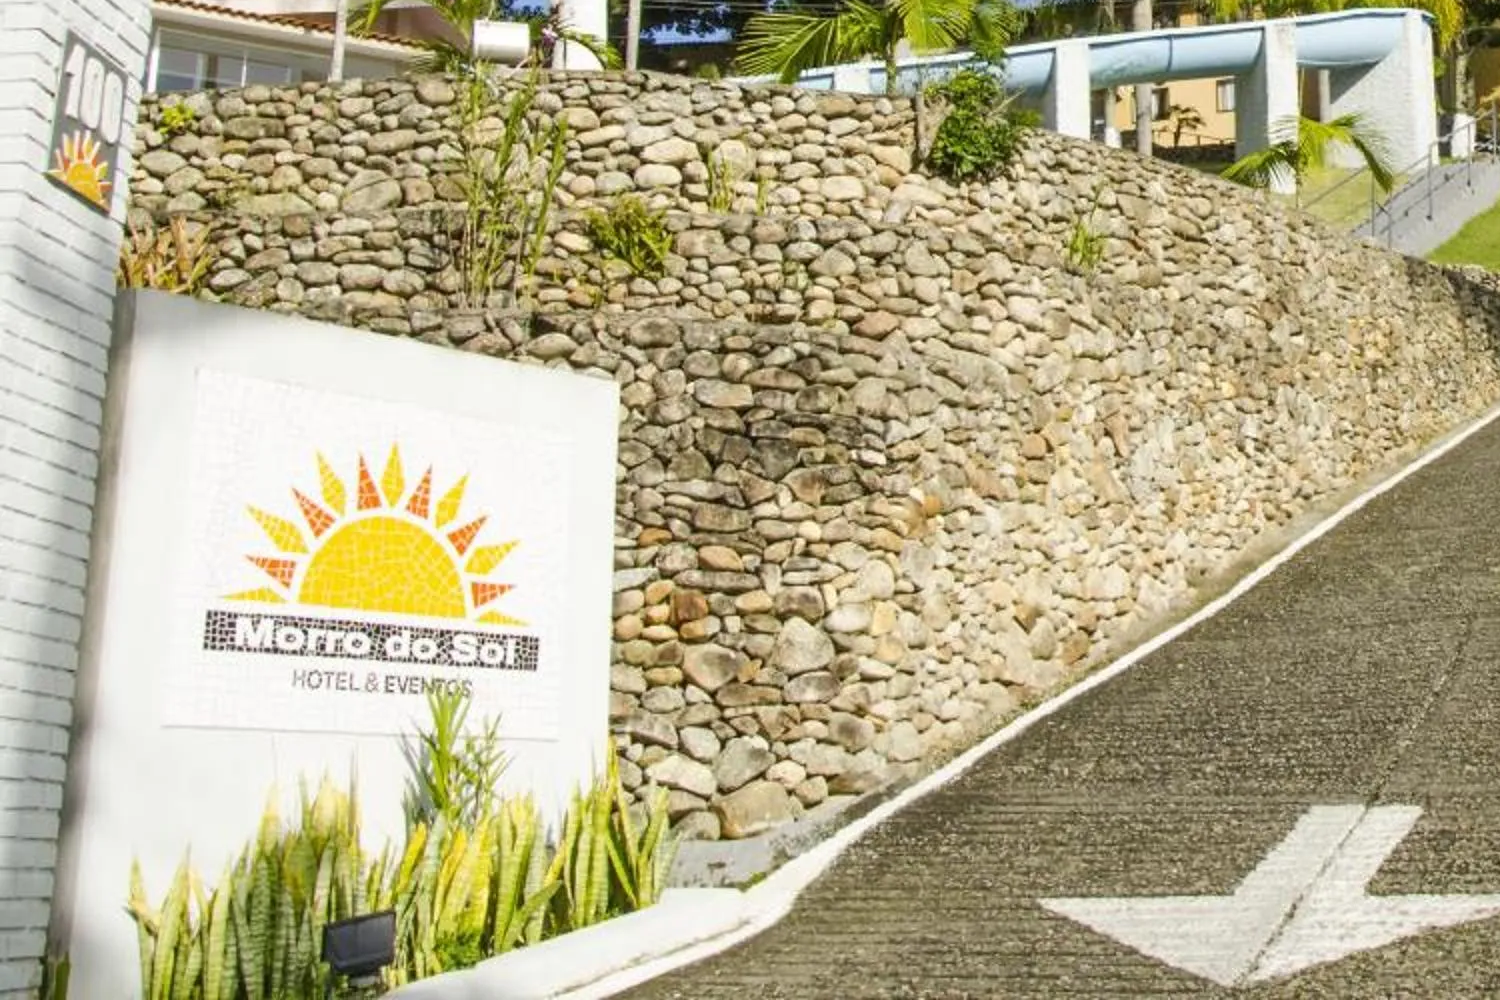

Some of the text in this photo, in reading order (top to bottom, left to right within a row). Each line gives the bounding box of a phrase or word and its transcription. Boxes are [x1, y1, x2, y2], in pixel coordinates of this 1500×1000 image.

[65, 44, 124, 144] 100
[235, 616, 517, 666] Morro do Sol
[292, 669, 359, 691] HOTEL
[364, 672, 378, 693] &
